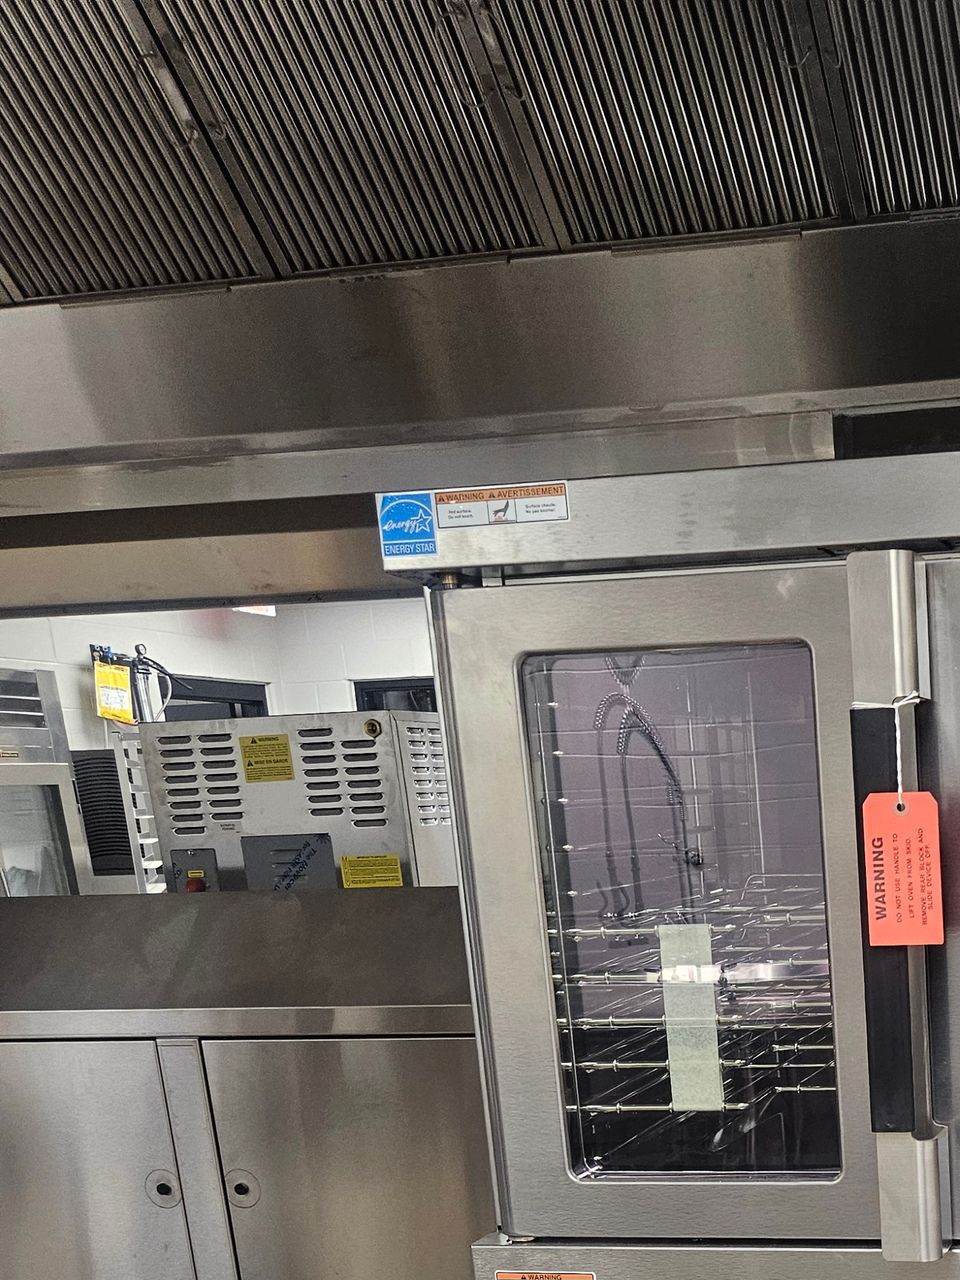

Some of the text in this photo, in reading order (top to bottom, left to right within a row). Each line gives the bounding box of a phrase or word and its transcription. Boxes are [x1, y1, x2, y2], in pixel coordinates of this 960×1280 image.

[446, 492, 484, 502] WARNING
[497, 486, 564, 498] AVERTISSEMENT
[385, 543, 435, 554] ENERGY STAR
[892, 833, 899, 842] TO
[871, 837, 887, 921] WARNING
[896, 913, 902, 923] DO
